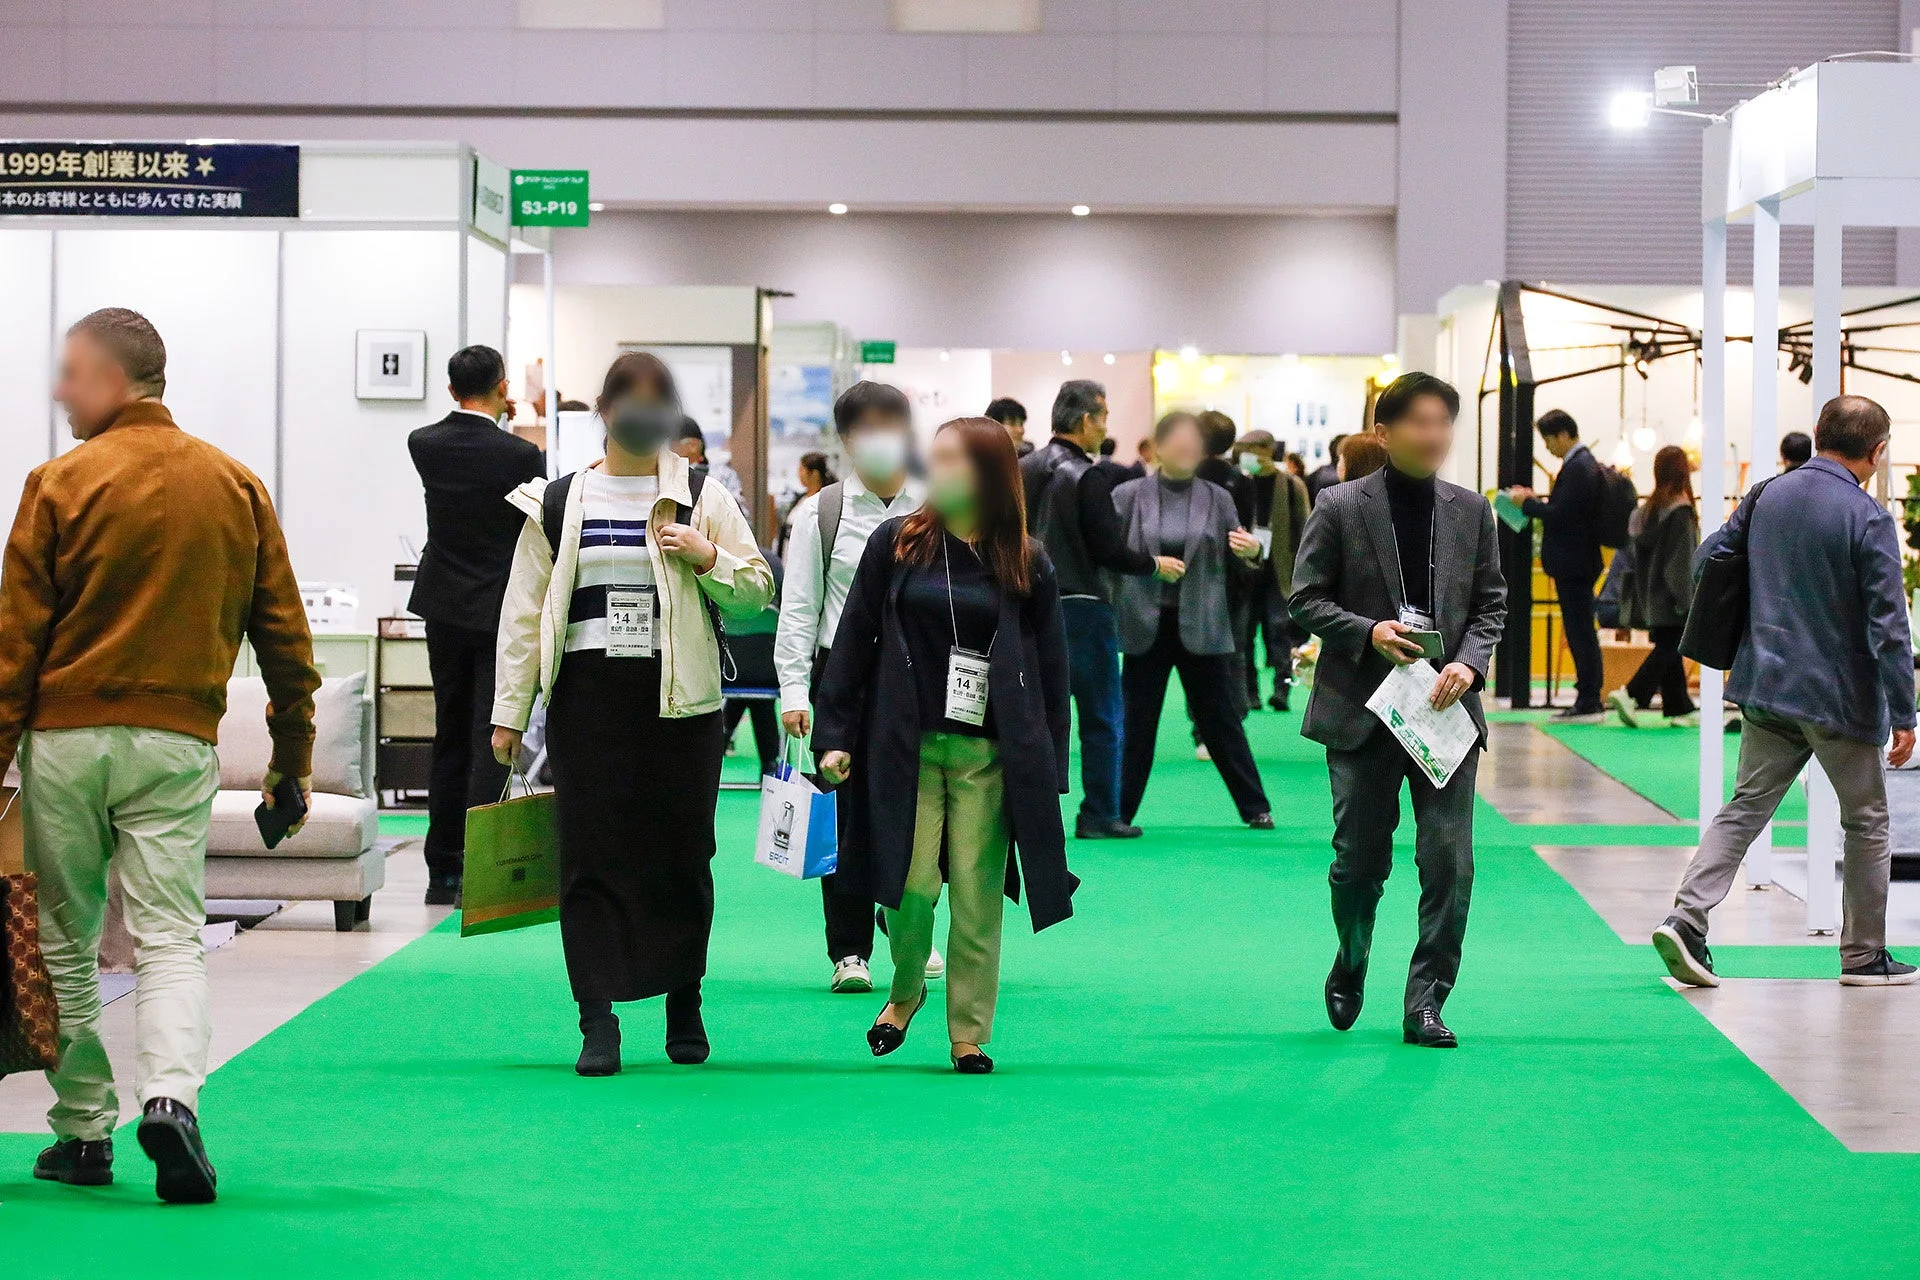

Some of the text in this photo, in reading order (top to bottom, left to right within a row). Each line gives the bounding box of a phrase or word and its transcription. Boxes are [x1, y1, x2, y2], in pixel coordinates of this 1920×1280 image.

[0, 190, 242, 209] 本のお客様とともに歩んできた実績
[521, 200, 578, 215] S3-P19
[613, 612, 631, 624] 14
[956, 677, 970, 690] 14
